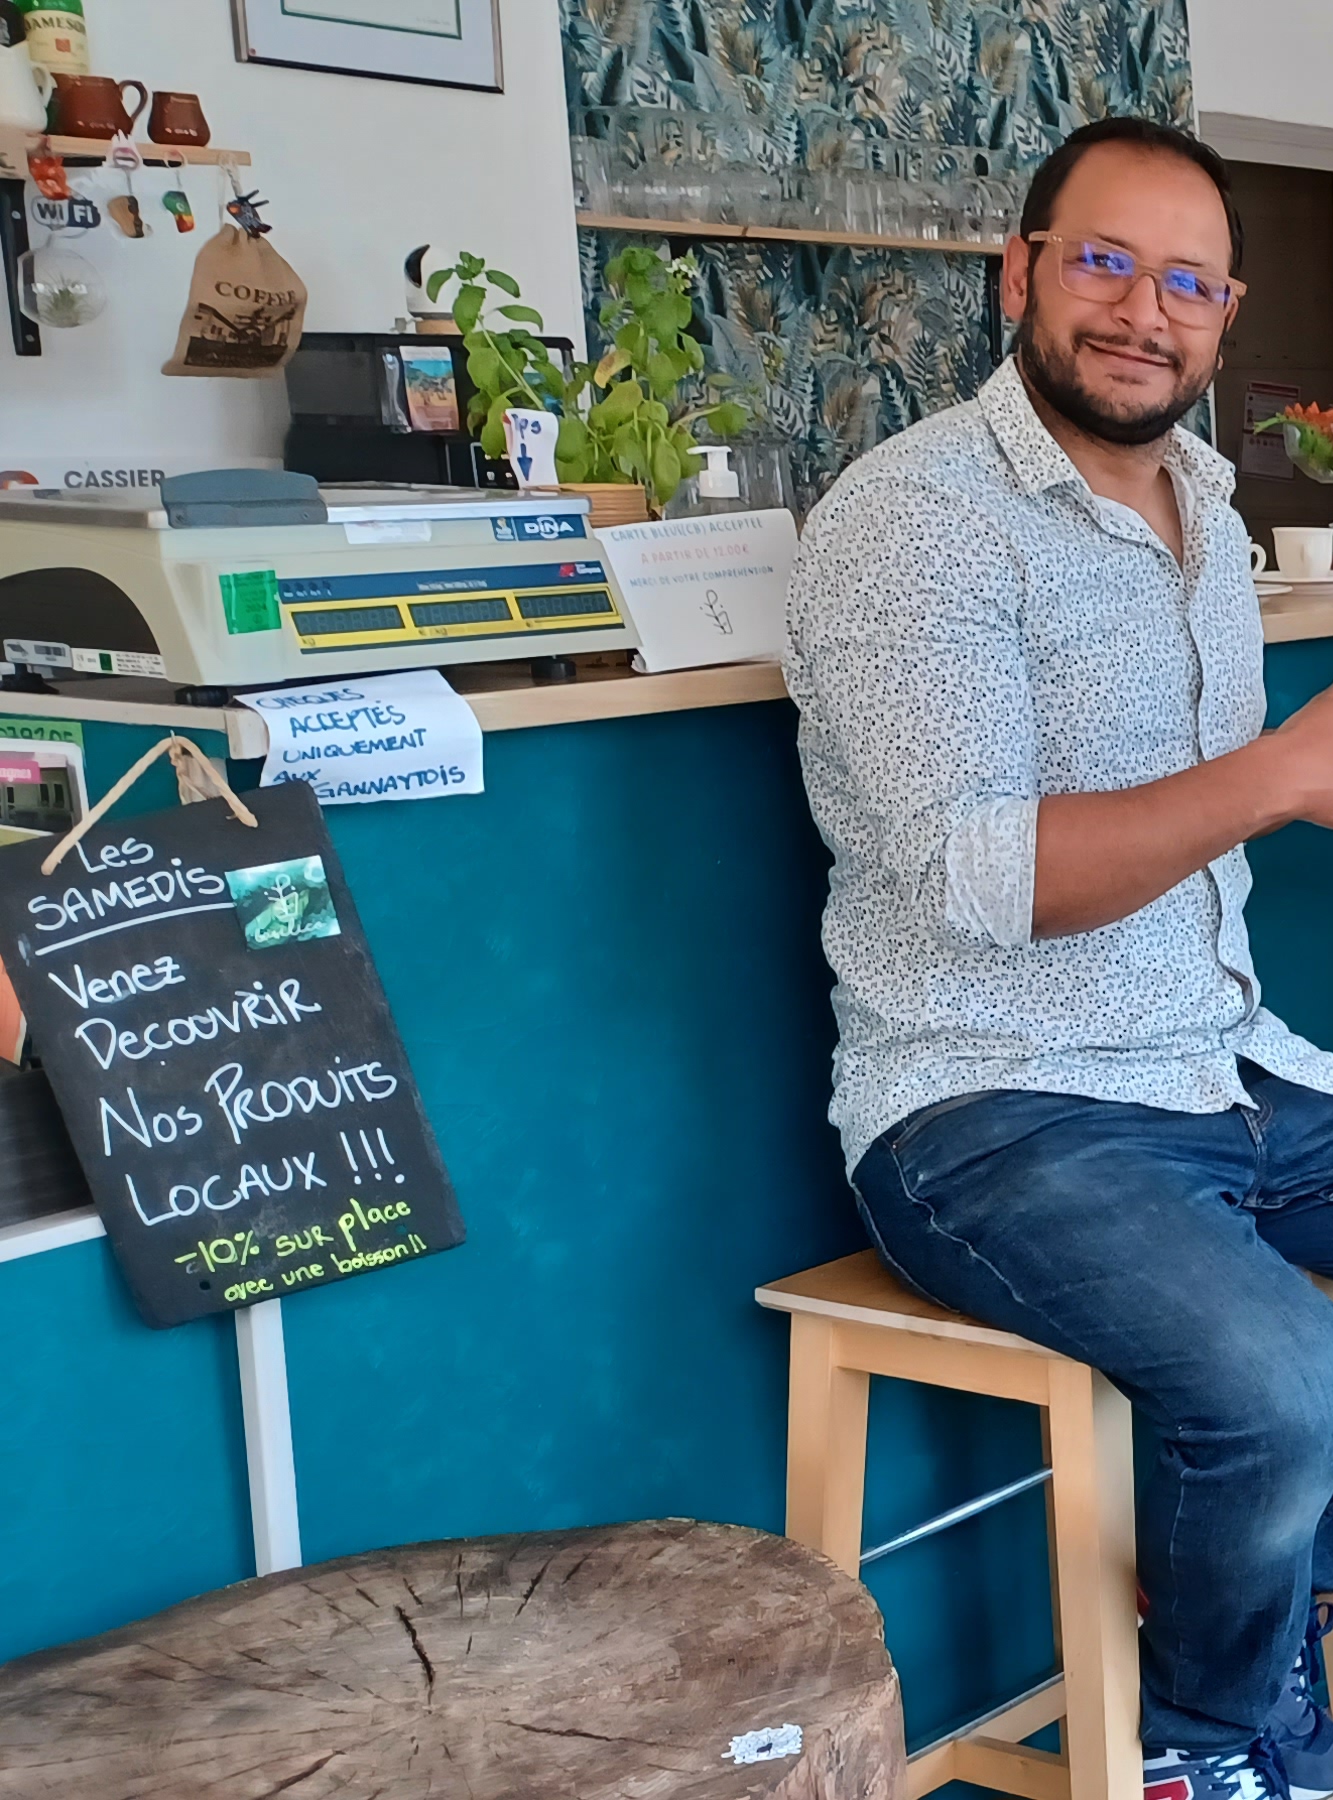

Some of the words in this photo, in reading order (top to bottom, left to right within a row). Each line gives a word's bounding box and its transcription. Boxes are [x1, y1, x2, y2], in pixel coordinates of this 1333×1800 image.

[214, 281, 297, 306] COFFEE
[64, 469, 165, 488] CASSIER
[611, 529, 648, 542] CARTE
[652, 549, 692, 563] PARTIR
[694, 547, 710, 560] DE
[283, 728, 427, 763] UNIQUEMENT
[74, 837, 154, 873] Les
[48, 956, 187, 1009] Venez
[125, 1152, 327, 1226] LOCAUX
[174, 1230, 260, 1272] -10%
[338, 1198, 411, 1252] place
[224, 1278, 273, 1301] avec
[282, 1263, 324, 1286] une
